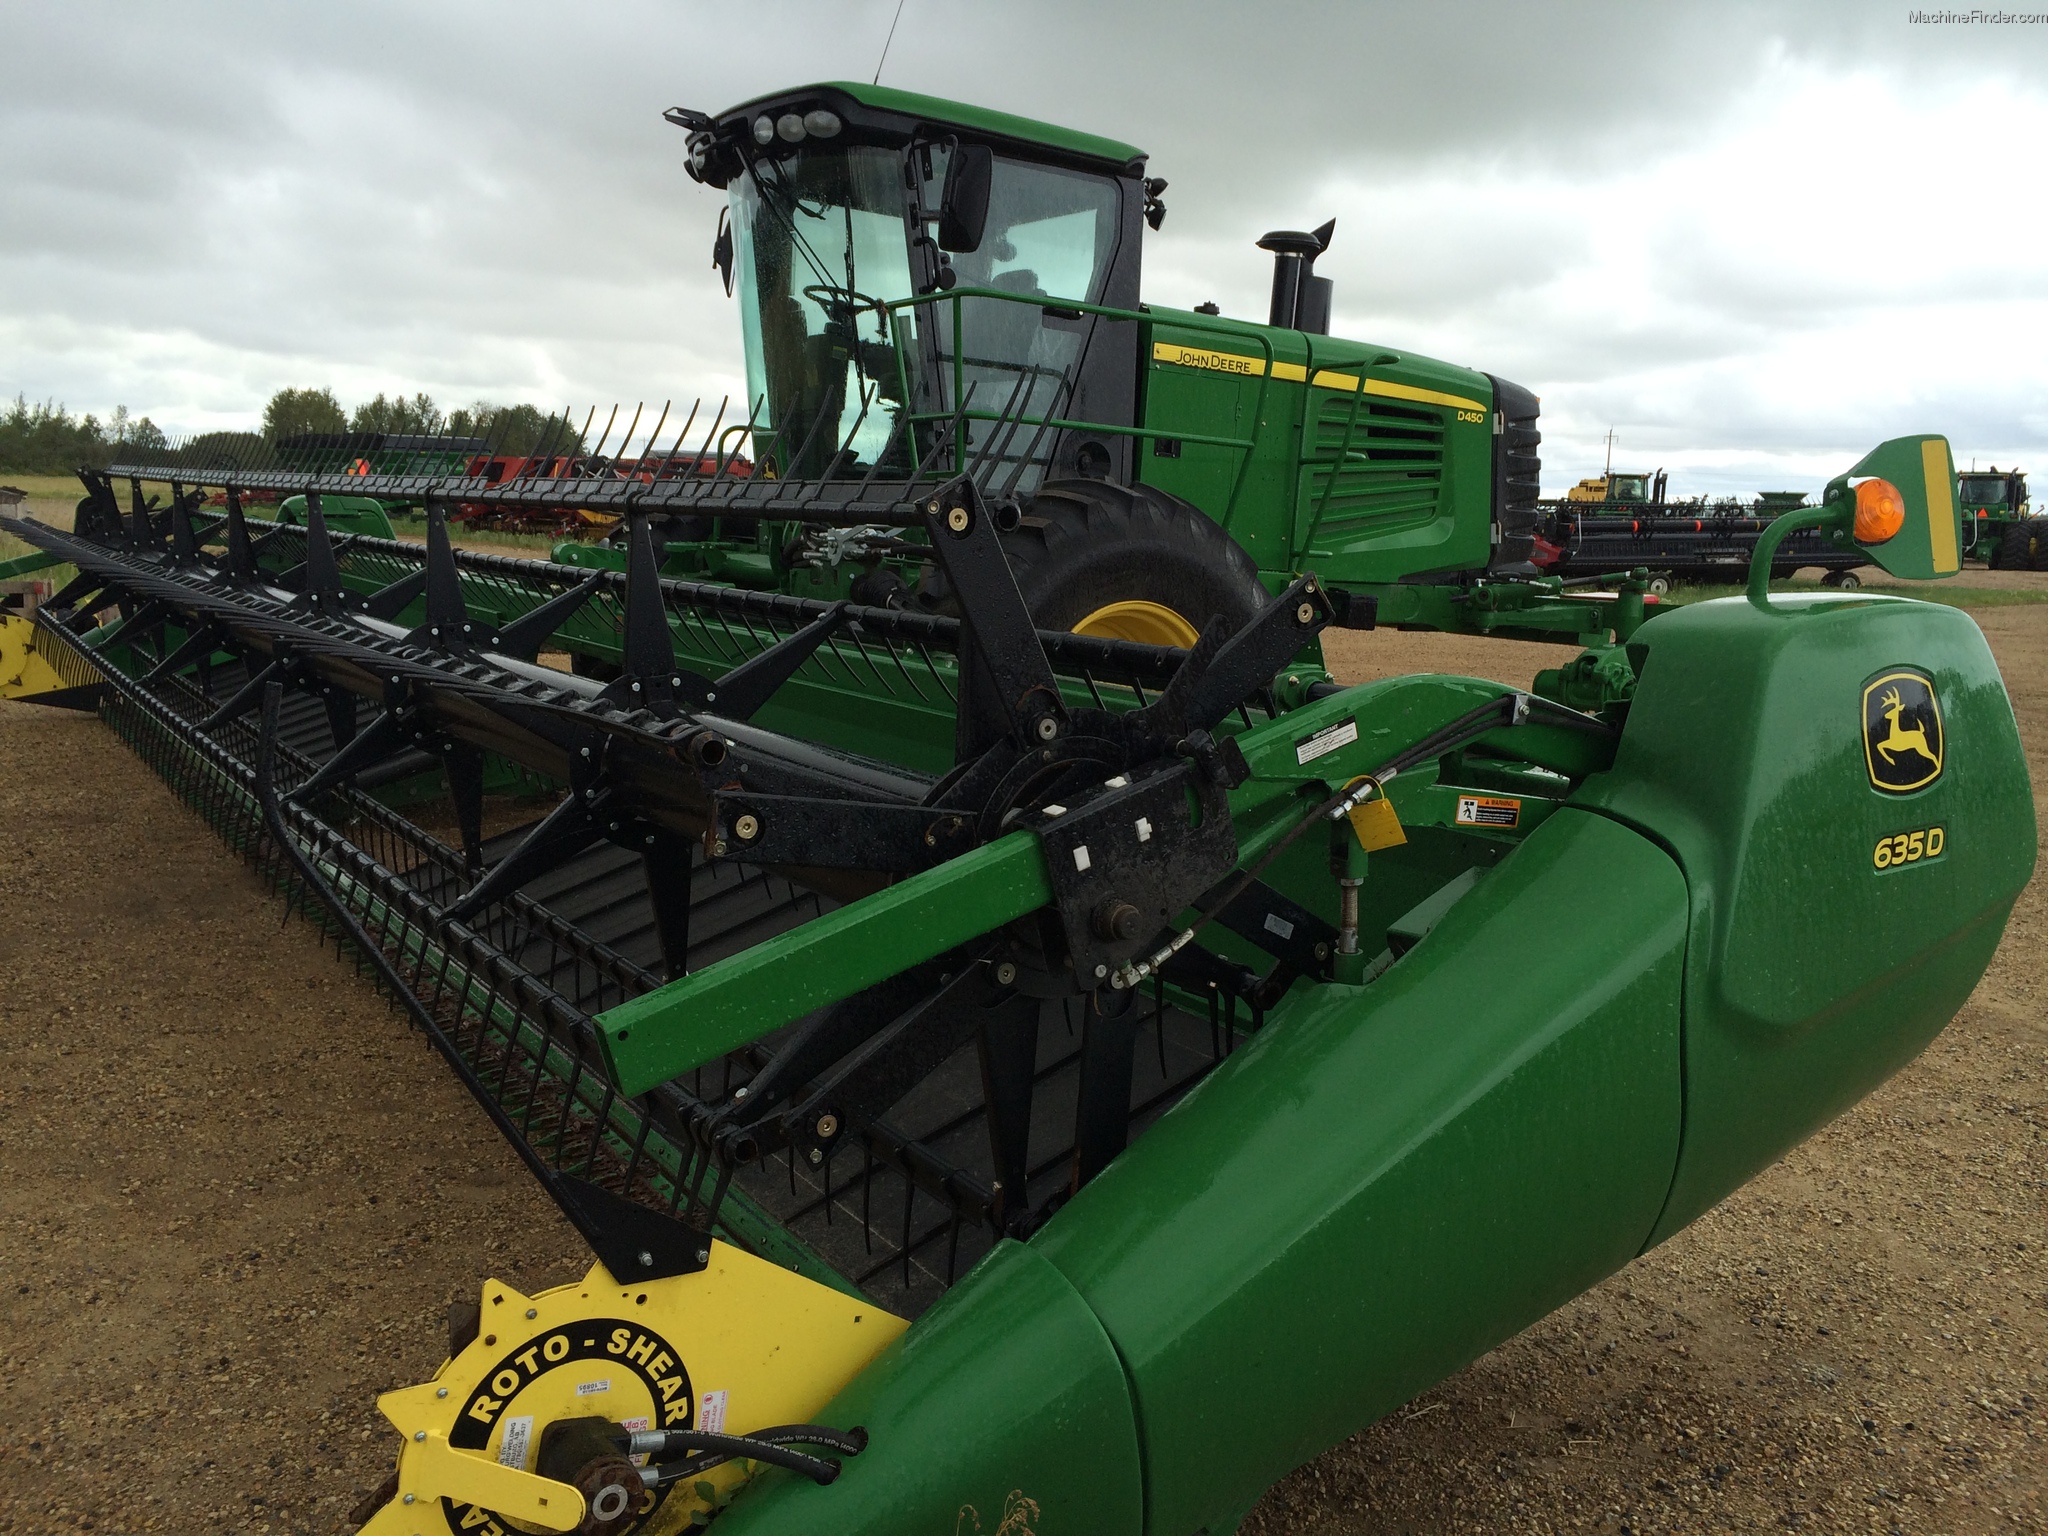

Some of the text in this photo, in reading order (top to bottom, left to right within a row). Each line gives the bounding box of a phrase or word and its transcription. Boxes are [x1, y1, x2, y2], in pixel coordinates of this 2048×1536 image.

[1176, 350, 1251, 373] JOHN DEERE
[1457, 411, 1484, 424] D450
[1312, 723, 1339, 740] IMPORTANT
[1491, 799, 1514, 807] WARNING
[1873, 827, 1945, 869] 635D
[468, 1334, 570, 1424] ROTO
[606, 1328, 688, 1426] SHEAR
